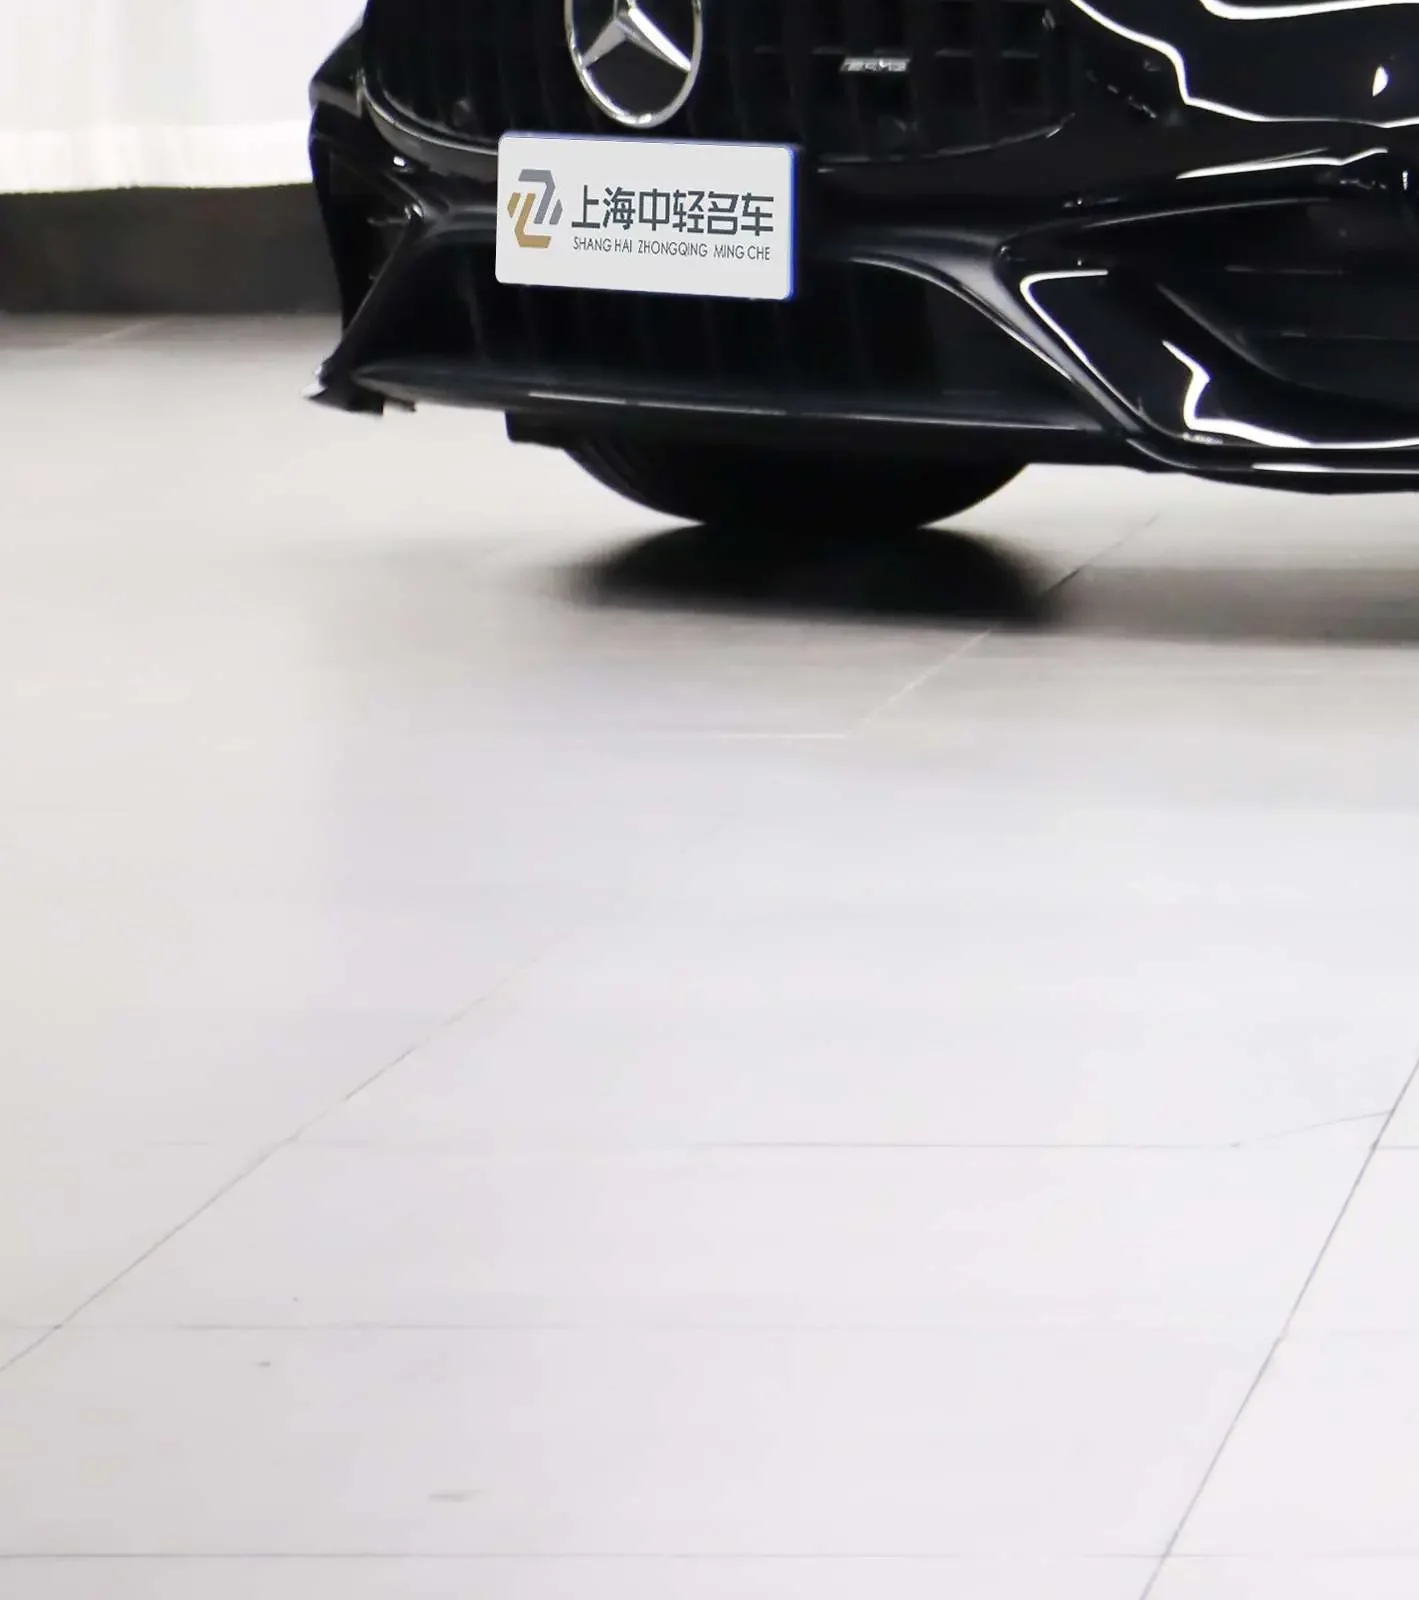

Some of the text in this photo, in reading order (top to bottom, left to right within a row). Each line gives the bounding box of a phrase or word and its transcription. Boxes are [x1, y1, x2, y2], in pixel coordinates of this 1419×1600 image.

[571, 184, 774, 237] 上海中轻名车
[573, 236, 771, 260] SHANG HAI ZHONGQING MING CHE
